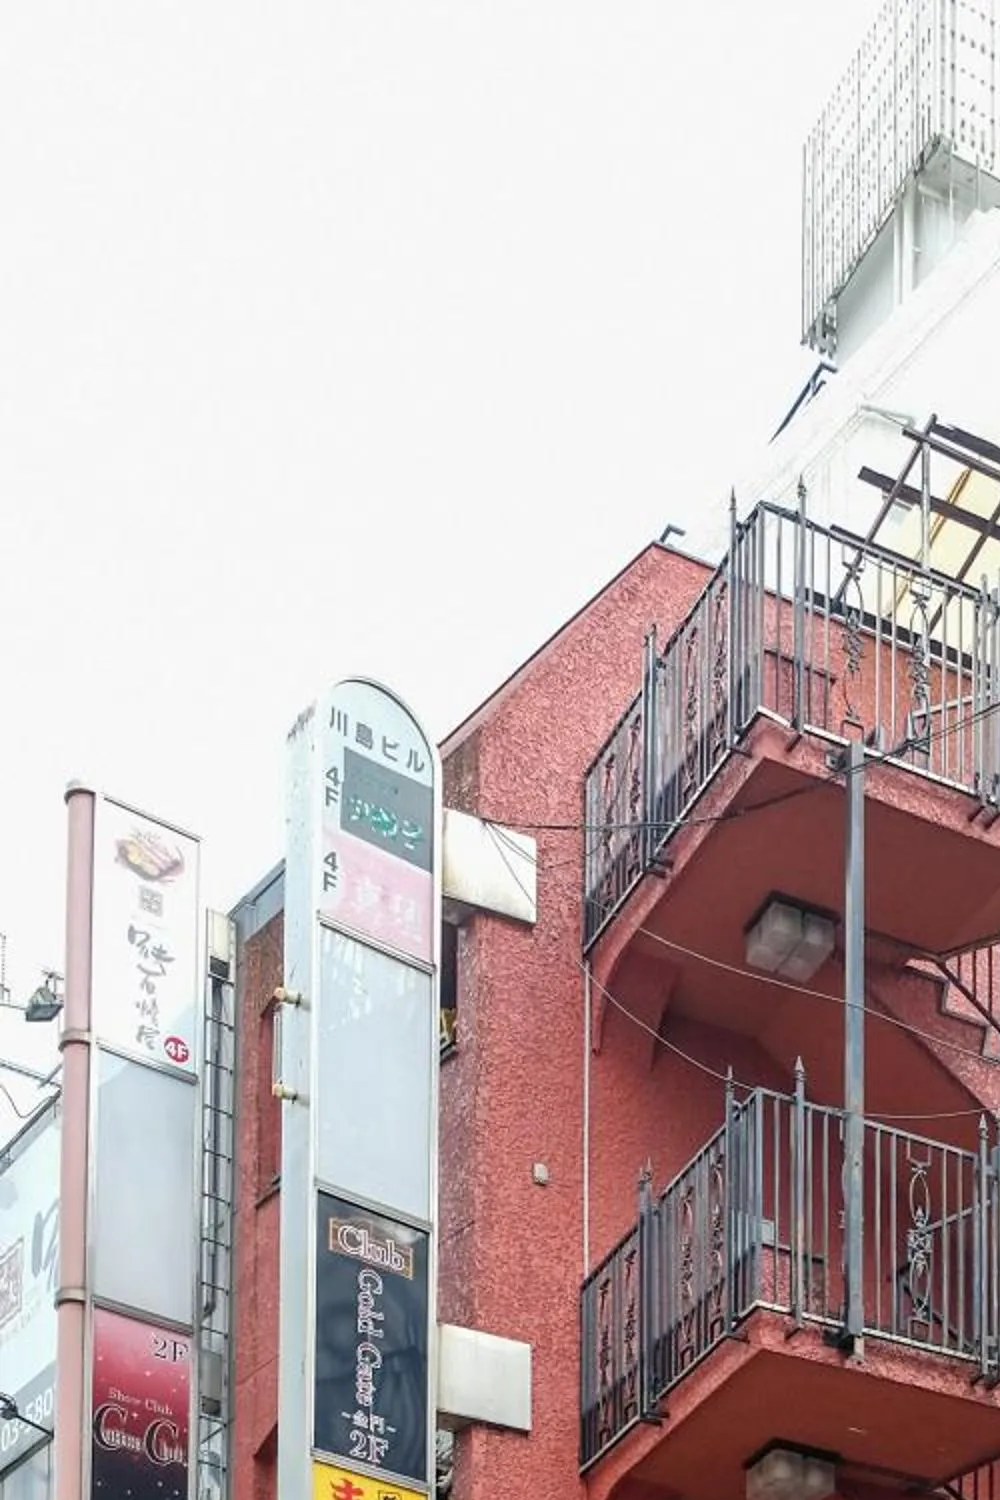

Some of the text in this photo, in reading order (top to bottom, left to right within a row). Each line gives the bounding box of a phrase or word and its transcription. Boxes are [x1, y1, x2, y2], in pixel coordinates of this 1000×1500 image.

[329, 706, 425, 773] 川島ビル
[325, 767, 341, 807] 4F
[323, 851, 338, 892] 4F
[167, 1043, 189, 1060] 4F
[337, 1225, 405, 1272] Club
[152, 1333, 189, 1363] 2F
[350, 1431, 389, 1463] 2F
